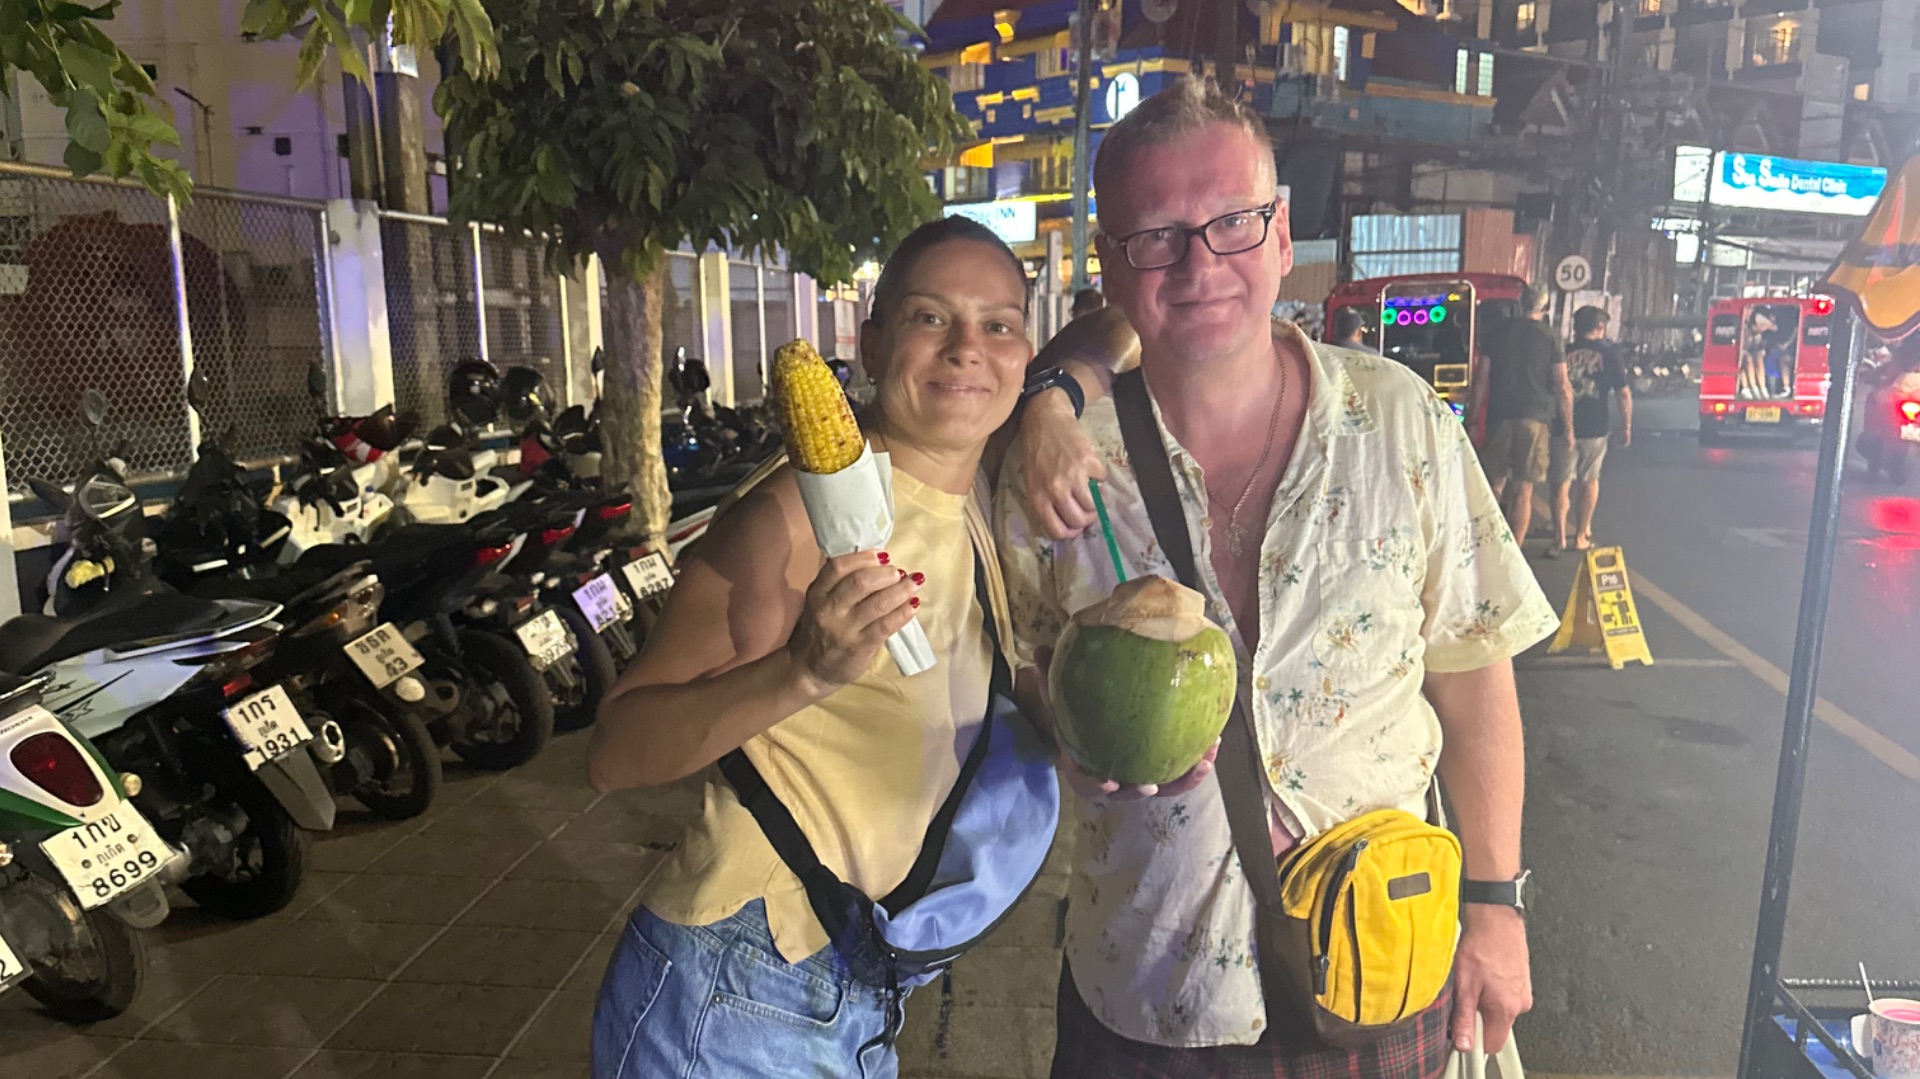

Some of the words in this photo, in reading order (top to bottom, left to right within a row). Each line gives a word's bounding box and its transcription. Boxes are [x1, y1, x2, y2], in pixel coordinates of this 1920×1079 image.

[1560, 264, 1586, 282] 50
[239, 695, 276, 723] 1กร
[256, 727, 301, 760] 1931
[92, 851, 157, 897] 8699
